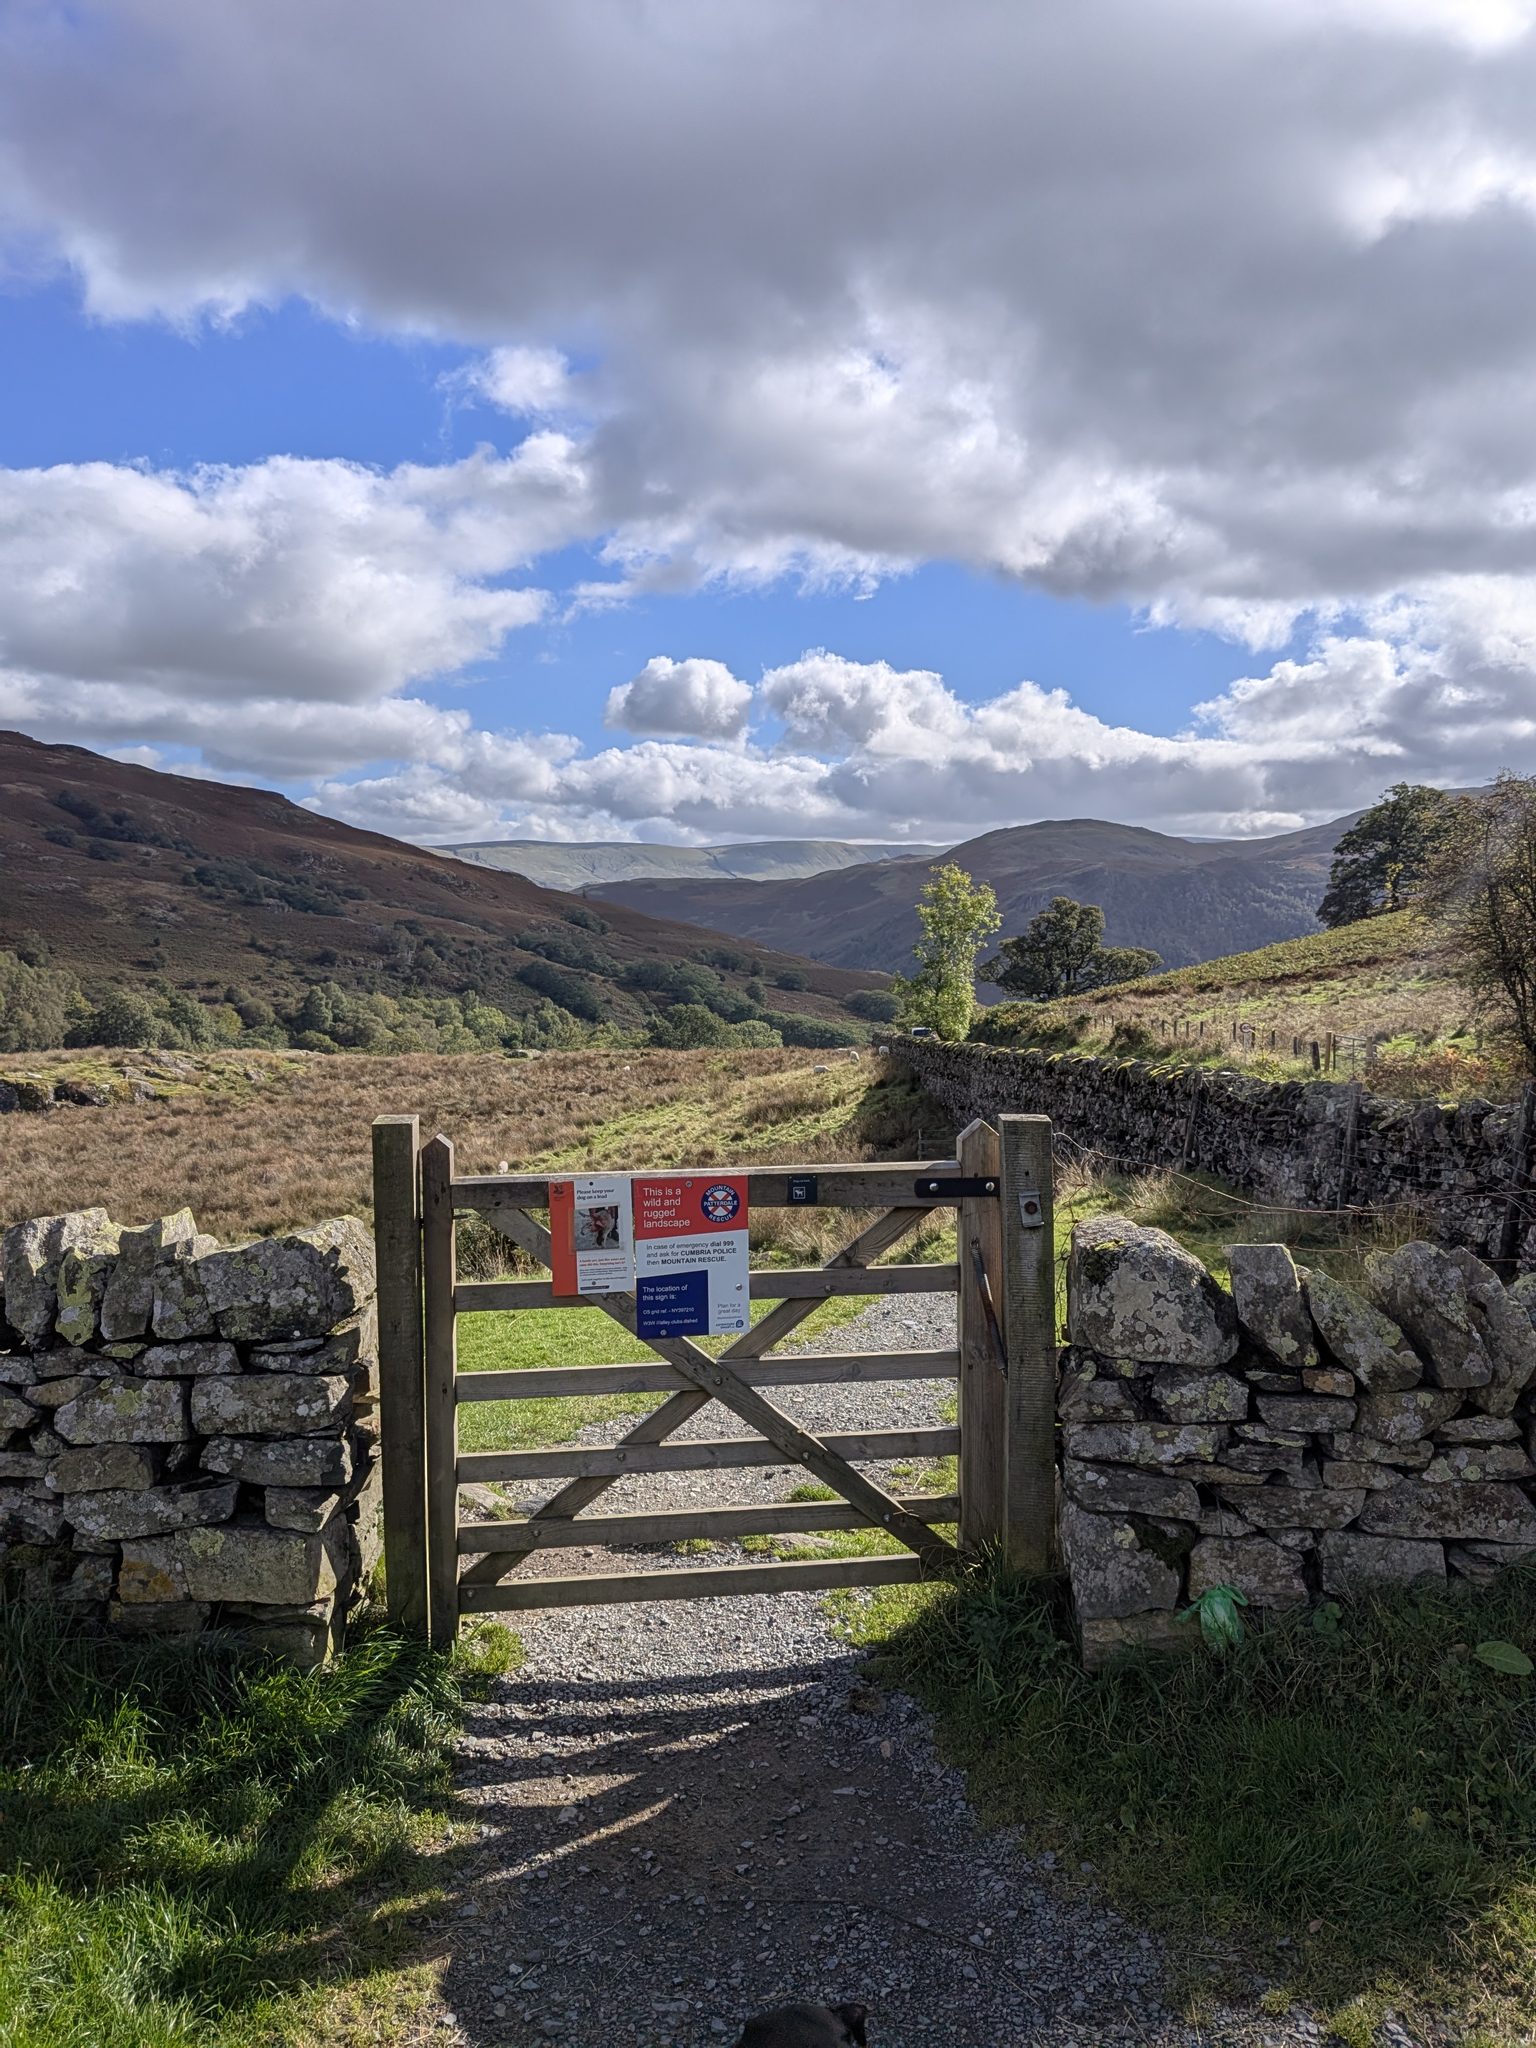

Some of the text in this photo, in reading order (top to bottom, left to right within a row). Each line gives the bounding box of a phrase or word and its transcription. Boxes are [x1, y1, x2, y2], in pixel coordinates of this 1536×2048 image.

[643, 1188, 662, 1196] This
[706, 1185, 735, 1196] MOUNTAIN
[644, 1209, 675, 1219] rugged
[709, 1214, 733, 1222] RESCUE
[644, 1219, 690, 1228] landscape
